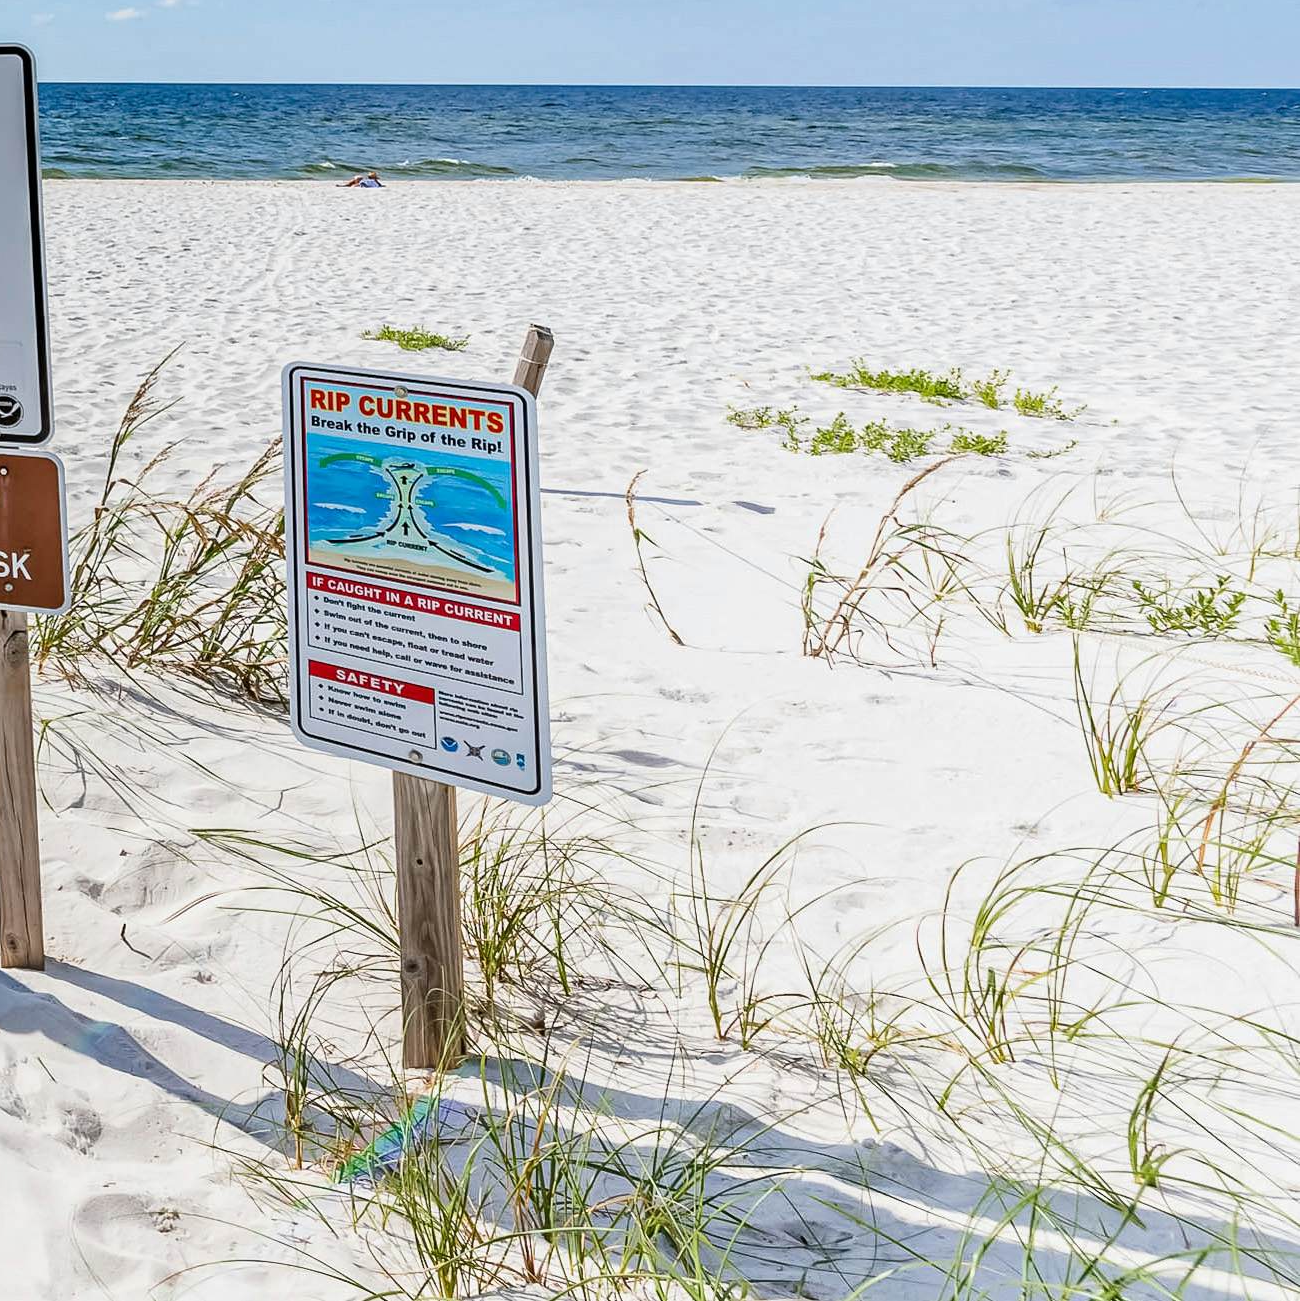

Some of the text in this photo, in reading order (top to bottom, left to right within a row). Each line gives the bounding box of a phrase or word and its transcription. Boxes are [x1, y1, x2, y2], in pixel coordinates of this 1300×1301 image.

[311, 389, 503, 433] RIP CURRENTS
[311, 415, 502, 454] Break the Grip of the Rip!
[398, 541, 428, 552] CURRENT
[312, 576, 513, 626] IF CAUGHT IN A RIP CURRENT
[323, 596, 415, 622] Don't fight the current
[324, 610, 346, 620] Swim
[348, 616, 362, 624] out
[375, 621, 389, 629] the
[391, 625, 425, 638] current,
[428, 632, 448, 642] then
[450, 637, 459, 645] to
[462, 640, 487, 651] shore
[332, 626, 347, 634] you
[349, 630, 370, 639] can't
[372, 635, 405, 648] escape,
[408, 642, 428, 652] float
[441, 649, 465, 660] tread
[468, 655, 494, 666] water
[333, 639, 347, 647] you
[350, 643, 370, 652] need
[372, 647, 393, 659] help,
[395, 653, 411, 662] call
[425, 660, 448, 670] wave
[450, 665, 463, 673] for
[465, 669, 515, 685] assistance
[328, 685, 351, 696] Know
[353, 691, 370, 701] how
[383, 699, 407, 710] swim
[336, 669, 405, 694] SAFETY
[328, 696, 402, 720] Never swim alone
[337, 710, 345, 718] in
[347, 713, 373, 726] doubt,
[375, 721, 396, 731] don't
[399, 727, 409, 735] go
[412, 729, 426, 739] out
